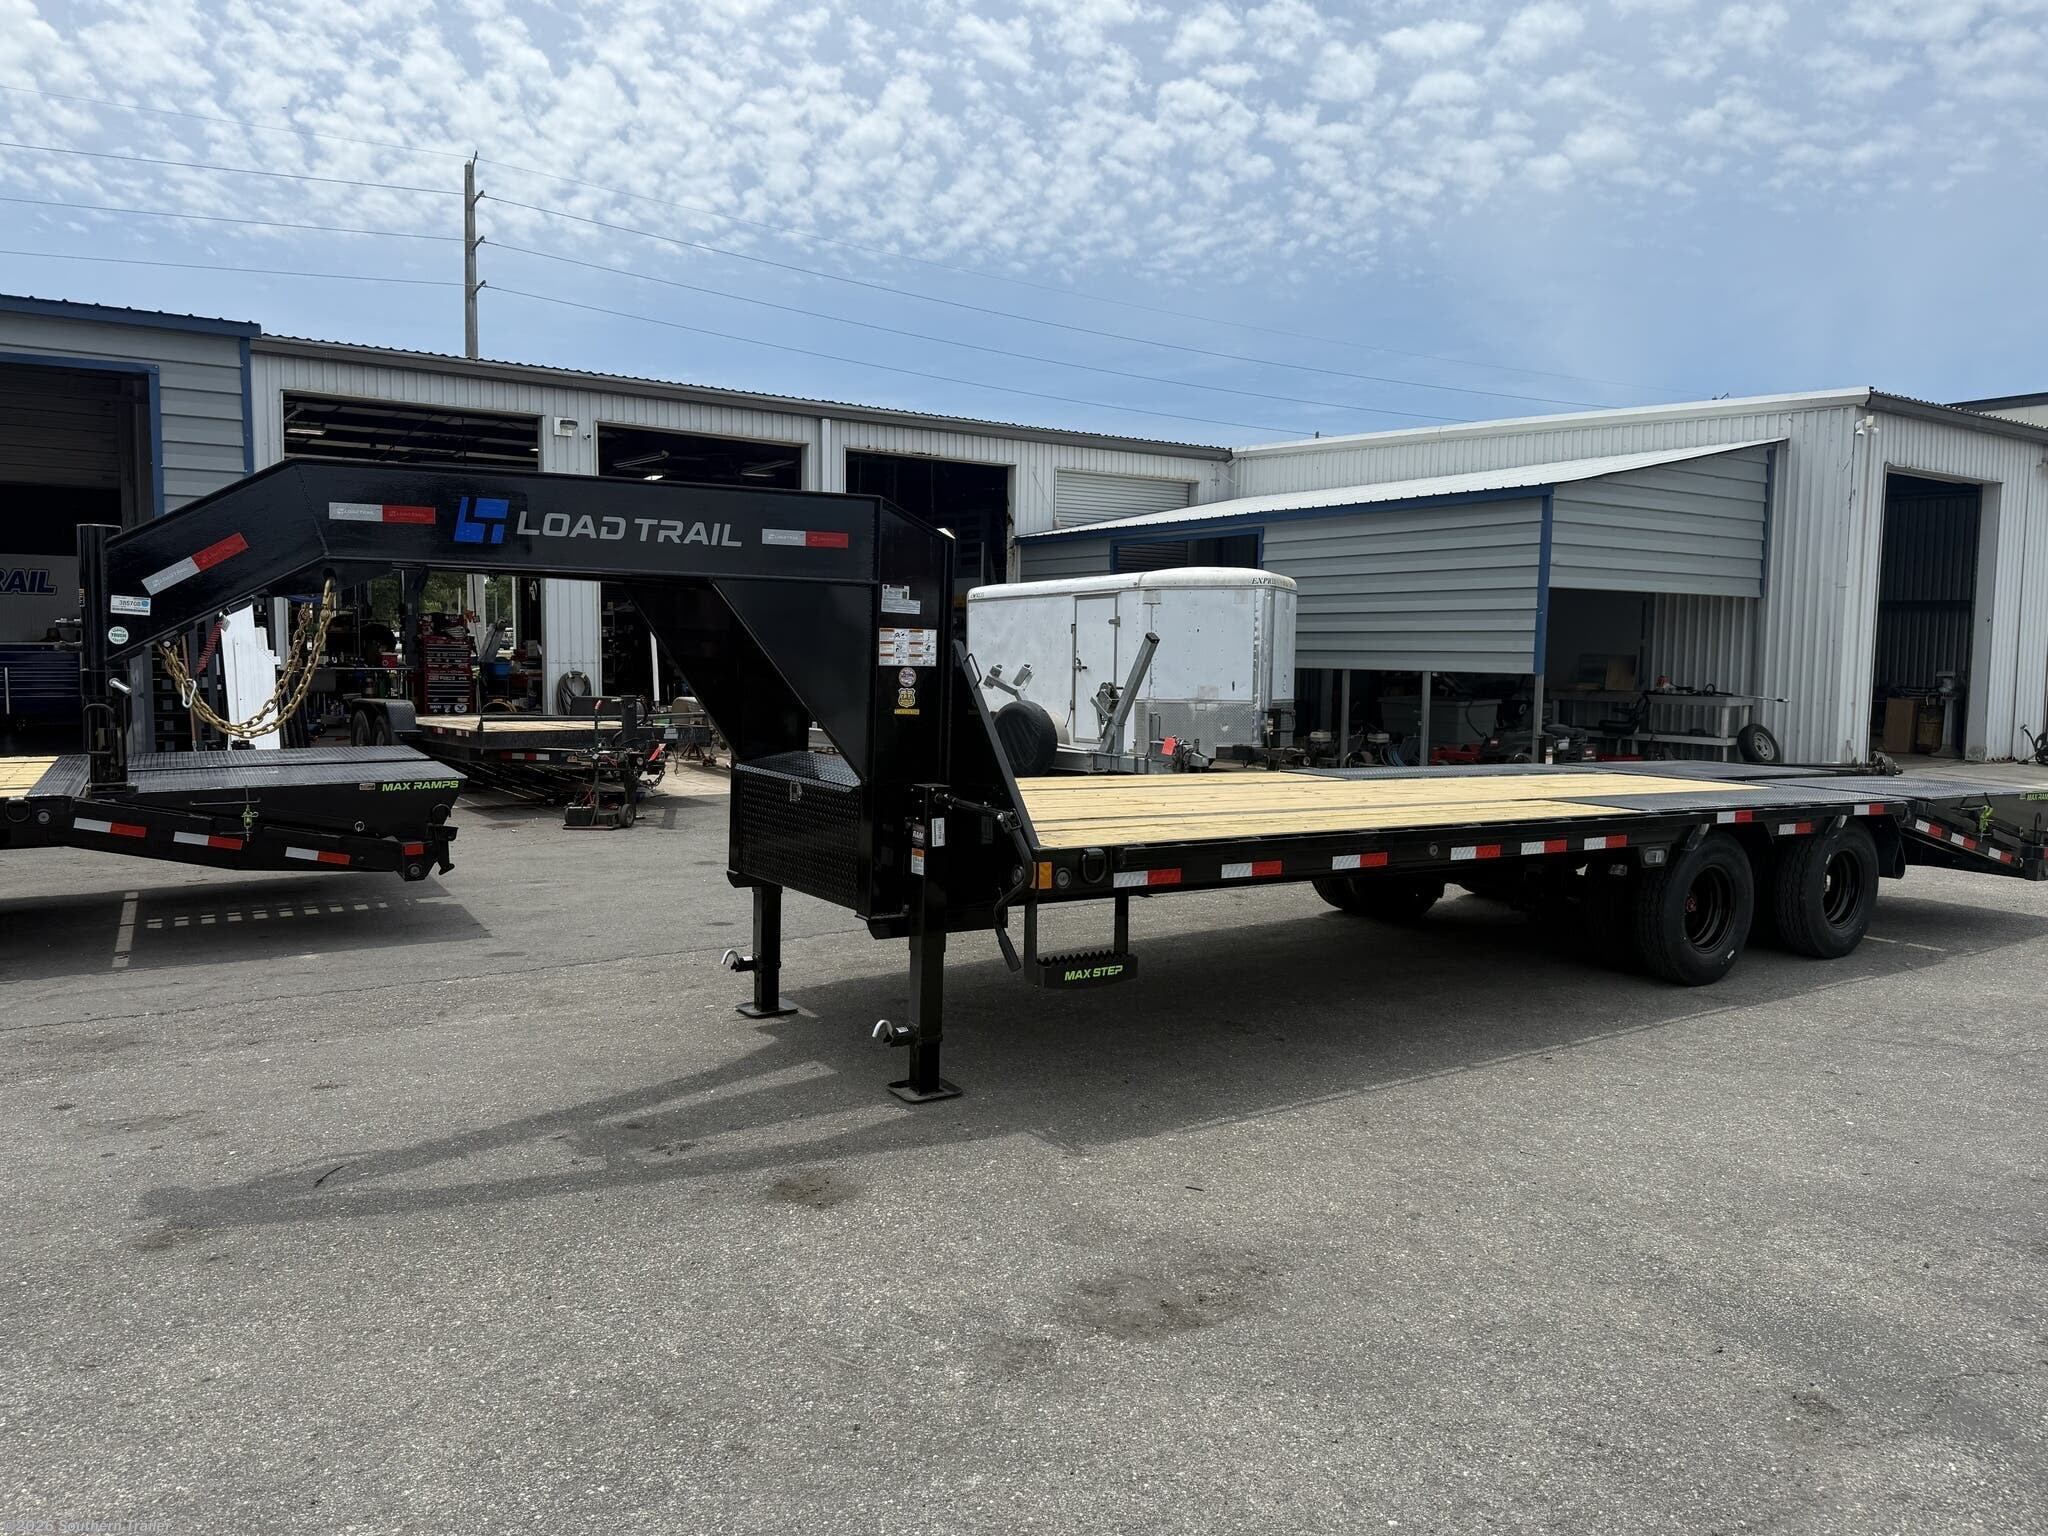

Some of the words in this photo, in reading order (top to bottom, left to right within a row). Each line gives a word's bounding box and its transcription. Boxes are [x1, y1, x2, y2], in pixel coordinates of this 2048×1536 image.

[516, 511, 627, 540] LOAD
[634, 518, 742, 547] TRAIL
[382, 782, 411, 792] MAX
[413, 780, 459, 790] RAMPS
[1064, 968, 1092, 981] MAX
[1092, 965, 1123, 977] STEP
